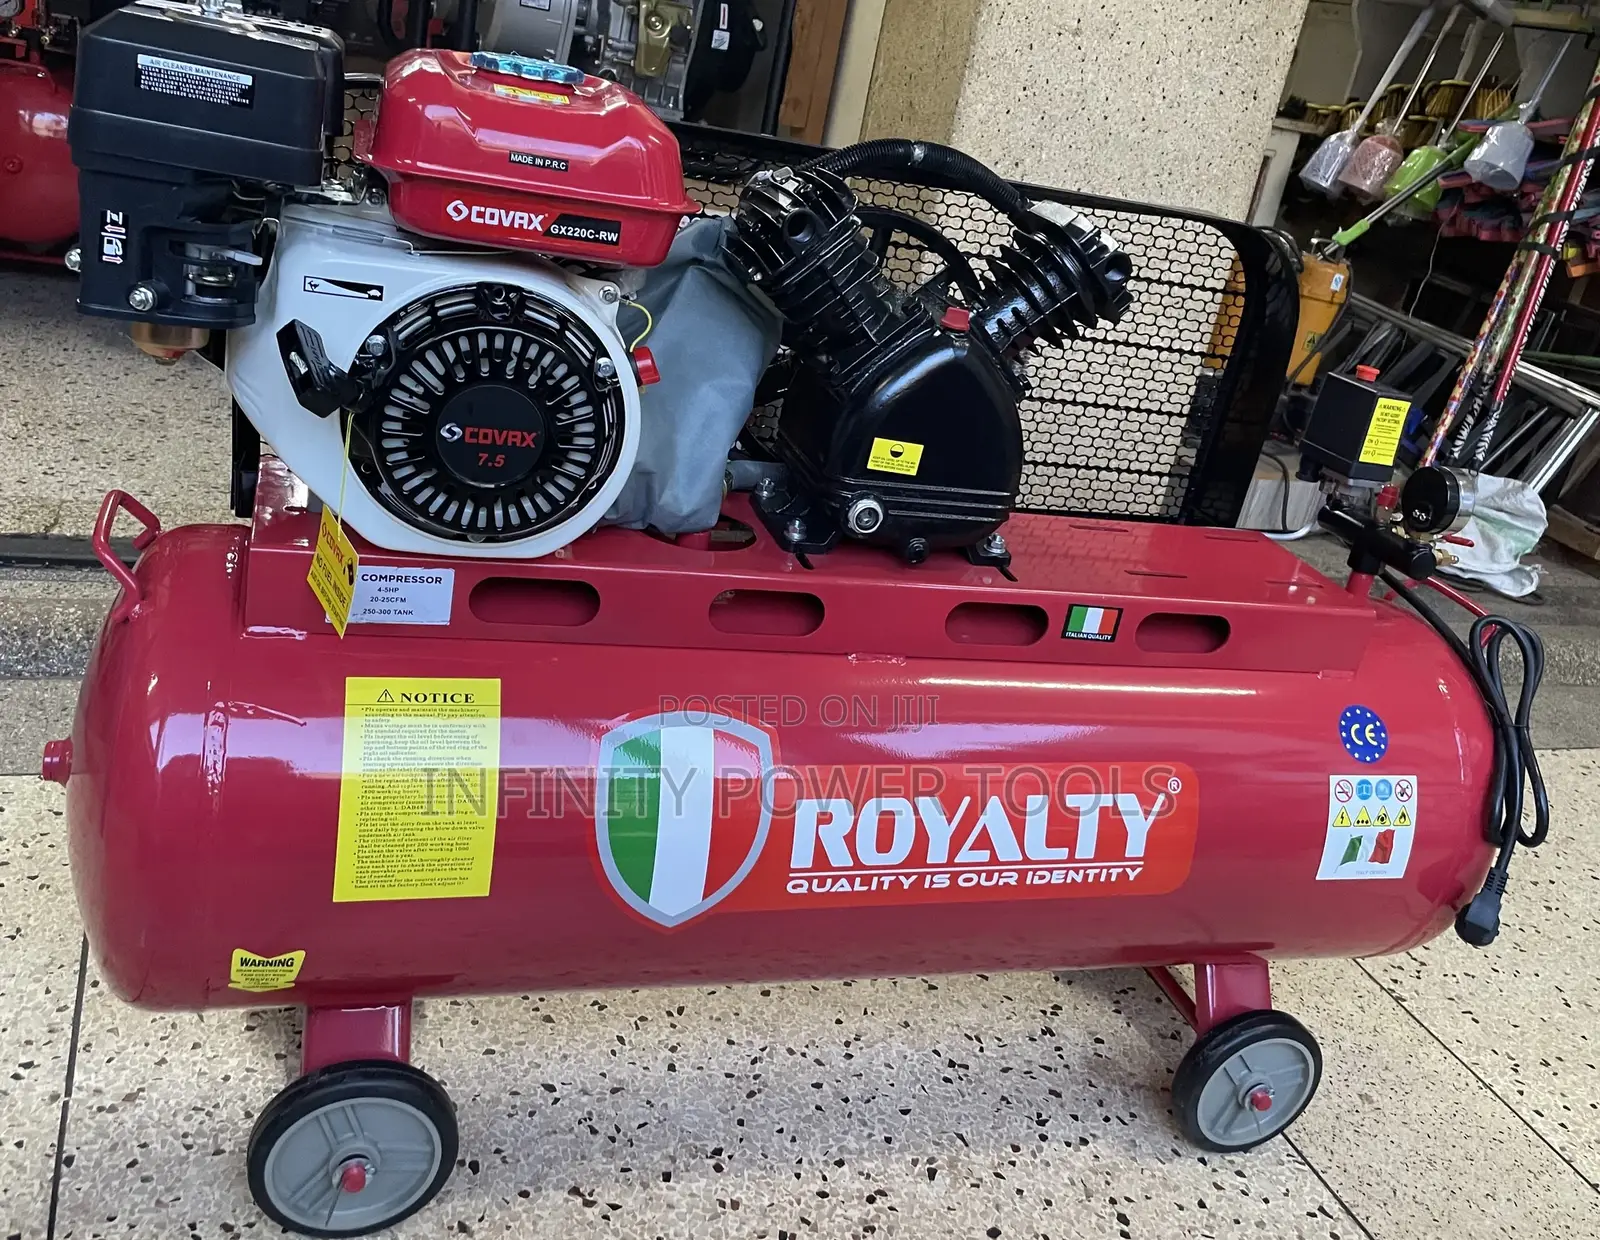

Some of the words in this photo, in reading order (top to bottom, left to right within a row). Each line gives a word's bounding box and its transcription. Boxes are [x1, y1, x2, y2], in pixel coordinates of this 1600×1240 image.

[150, 59, 161, 68] AIR
[162, 62, 193, 72] CLEANER
[195, 67, 240, 82] MAINTENANCE
[511, 153, 534, 165] MADE
[535, 158, 544, 166] IN
[544, 160, 567, 170] P.R.C
[471, 205, 545, 231] COVAX
[550, 224, 619, 242] GX220C-RW
[465, 427, 537, 448] COVAX
[478, 453, 506, 468] 7.5
[322, 563, 333, 586] FUEL
[361, 574, 442, 584] COMPRESSOR
[400, 692, 474, 704] NOTICE
[1350, 724, 1378, 746] CE
[790, 793, 1166, 868] ROYALTY
[786, 873, 911, 894] QUALITY
[924, 872, 950, 890] IS
[953, 871, 1018, 887] OUR
[1025, 868, 1143, 884] IDENTITY
[240, 957, 295, 968] WARNING
